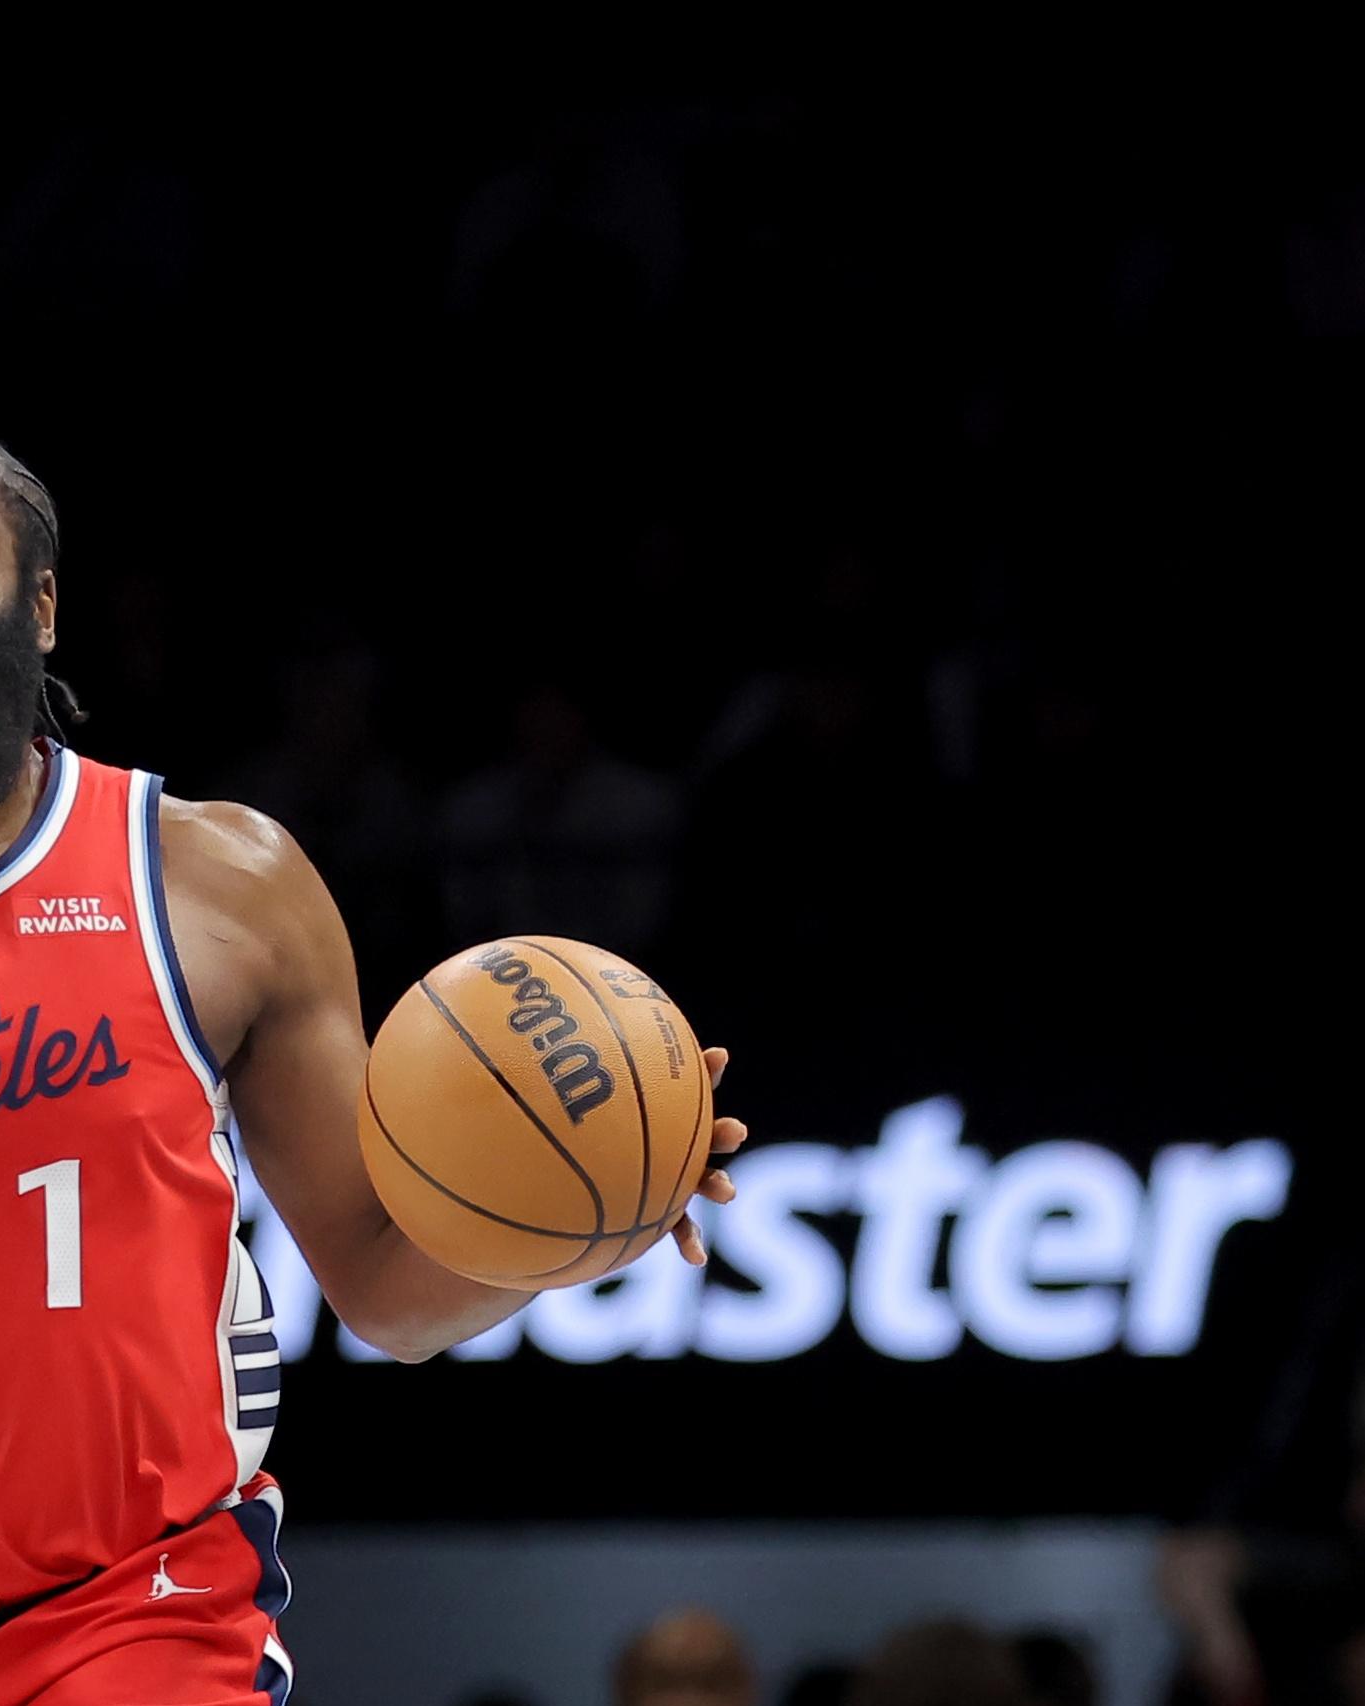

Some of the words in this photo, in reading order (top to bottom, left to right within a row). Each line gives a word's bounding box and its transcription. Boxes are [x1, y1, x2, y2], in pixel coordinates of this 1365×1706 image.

[18, 914, 128, 935] RWANDA
[39, 897, 101, 916] VISIT
[469, 945, 615, 1126] Wilson
[17, 1158, 82, 1309] 1
